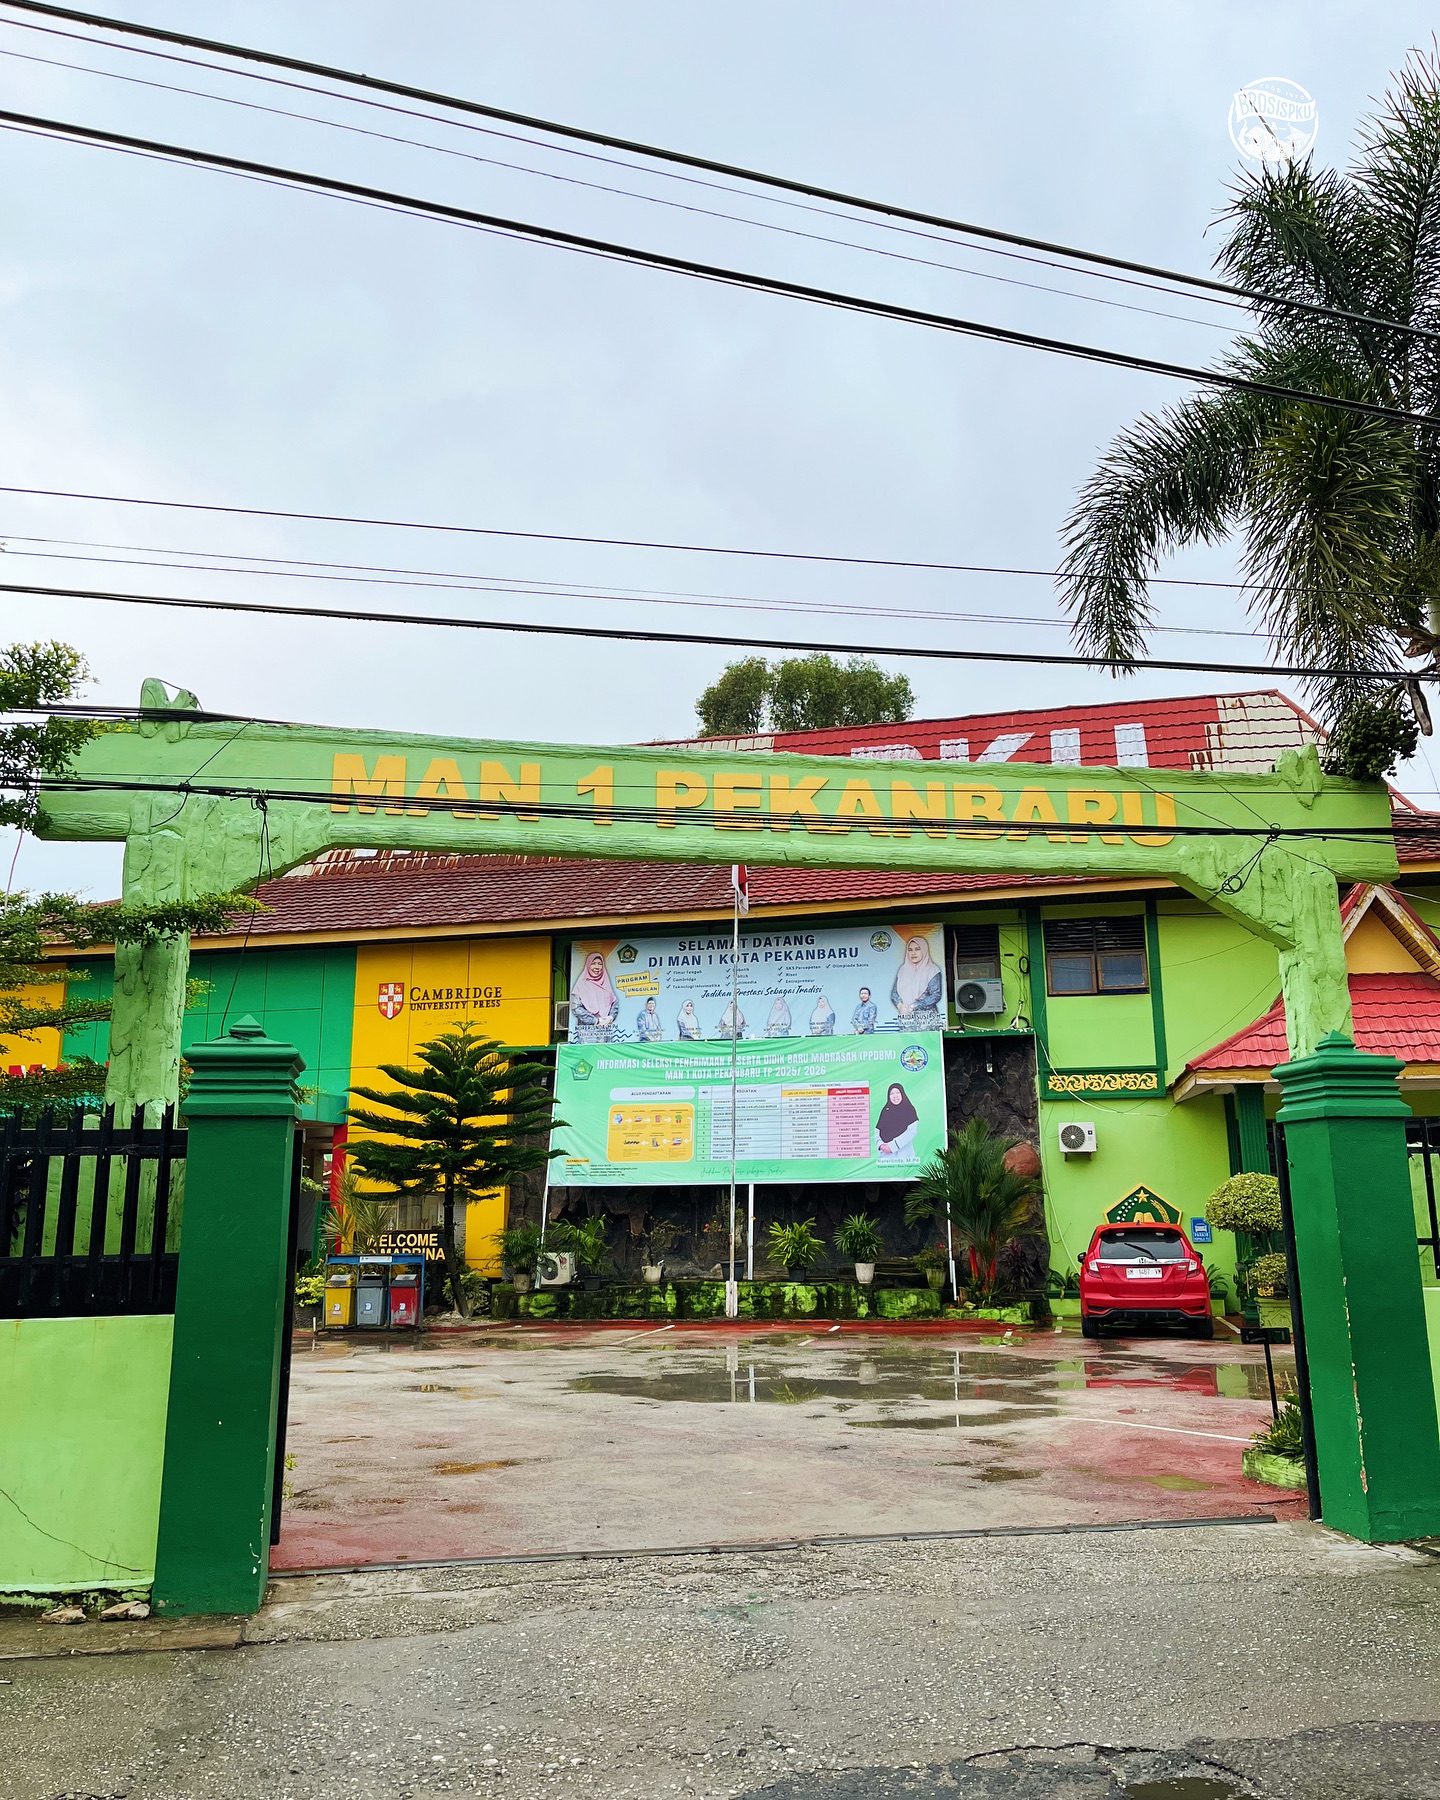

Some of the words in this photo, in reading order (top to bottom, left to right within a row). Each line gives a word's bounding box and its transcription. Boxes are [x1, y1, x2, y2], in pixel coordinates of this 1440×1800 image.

[330, 752, 541, 822] MAN
[577, 765, 613, 826] 1
[656, 769, 1176, 847] PEKANBARU
[678, 938, 748, 952] SELAMAT
[752, 934, 815, 948] DATANG
[648, 957, 662, 967] DI
[668, 955, 701, 967] MAN
[708, 954, 713, 965] 1
[720, 952, 760, 965] KOTA
[765, 947, 859, 962] PEKANBARU
[617, 975, 648, 984] PROGRAM
[410, 986, 502, 1001] CAMBRIDGE
[701, 989, 732, 999] Jadikan
[736, 987, 764, 997] Prestasi
[764, 986, 796, 999] Sebagai
[796, 985, 824, 995] Tradisi
[410, 1001, 468, 1011] UNIVERSITY
[473, 1000, 501, 1008] PRESS
[597, 1059, 639, 1070] INFORMASI
[641, 1058, 672, 1069] SELEKSI
[674, 1057, 724, 1068] PENERIMAAN
[727, 1055, 761, 1067] PSERTA
[763, 1054, 785, 1065] DIDIK
[787, 1053, 809, 1064] BARU
[811, 1051, 857, 1063] MADRASAH
[859, 1049, 896, 1061] (PPDBM)
[665, 1070, 683, 1080] MAN
[692, 1069, 712, 1079] KOTA
[714, 1067, 761, 1079] PEKANBARU
[763, 1067, 773, 1077] TP
[775, 1067, 801, 1077] 2025/
[804, 1066, 826, 1076] 2026
